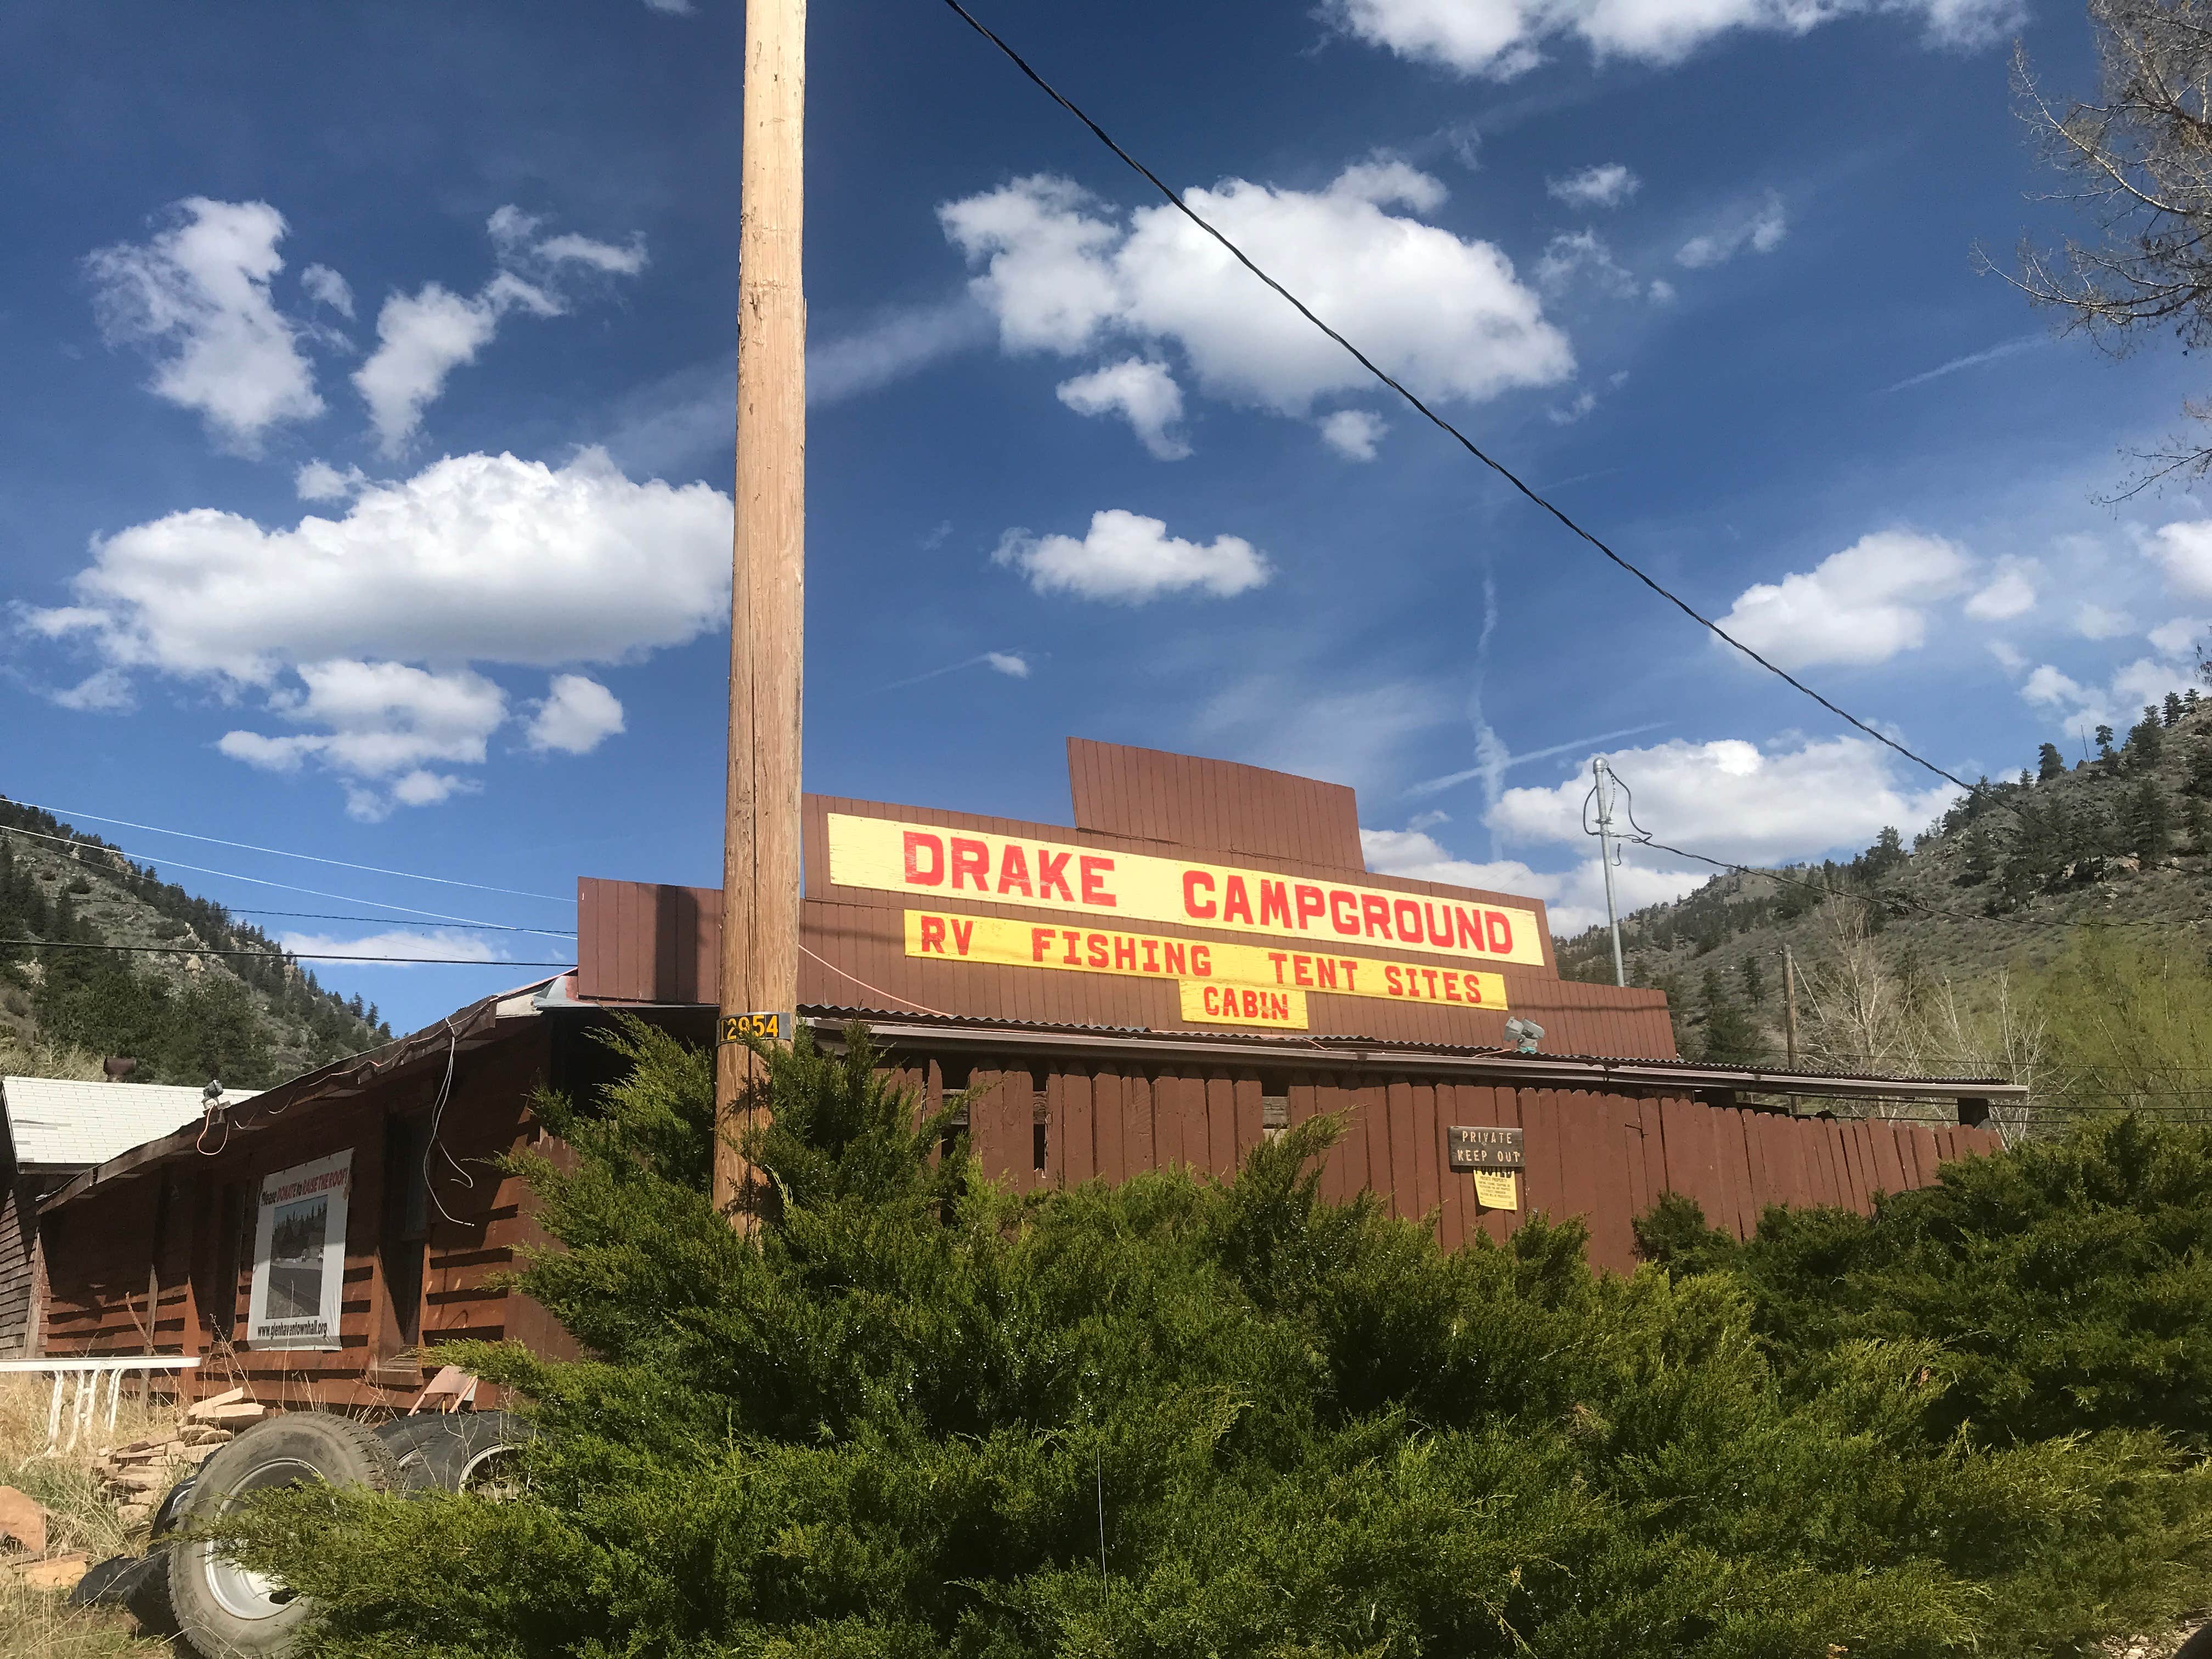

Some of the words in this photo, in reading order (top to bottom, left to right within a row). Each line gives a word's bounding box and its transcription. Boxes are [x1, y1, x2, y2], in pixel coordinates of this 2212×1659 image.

[903, 831, 1117, 907] DRAKE
[1183, 871, 1513, 954] CAMPGROUND
[921, 916, 973, 956] RV
[1032, 928, 1212, 977] FISHING
[1268, 952, 1358, 991] TENT
[1385, 966, 1482, 1003] SITES
[1204, 986, 1289, 1020] CABIN
[1462, 1130, 1513, 1144] PRIVATE
[1457, 1149, 1487, 1161] KEEP
[1497, 1150, 1519, 1163] OUT
[276, 1182, 297, 1203] DONATE
[302, 1176, 319, 1195] RAISE
[318, 1173, 330, 1190] THE
[329, 1167, 349, 1189] ROOF!
